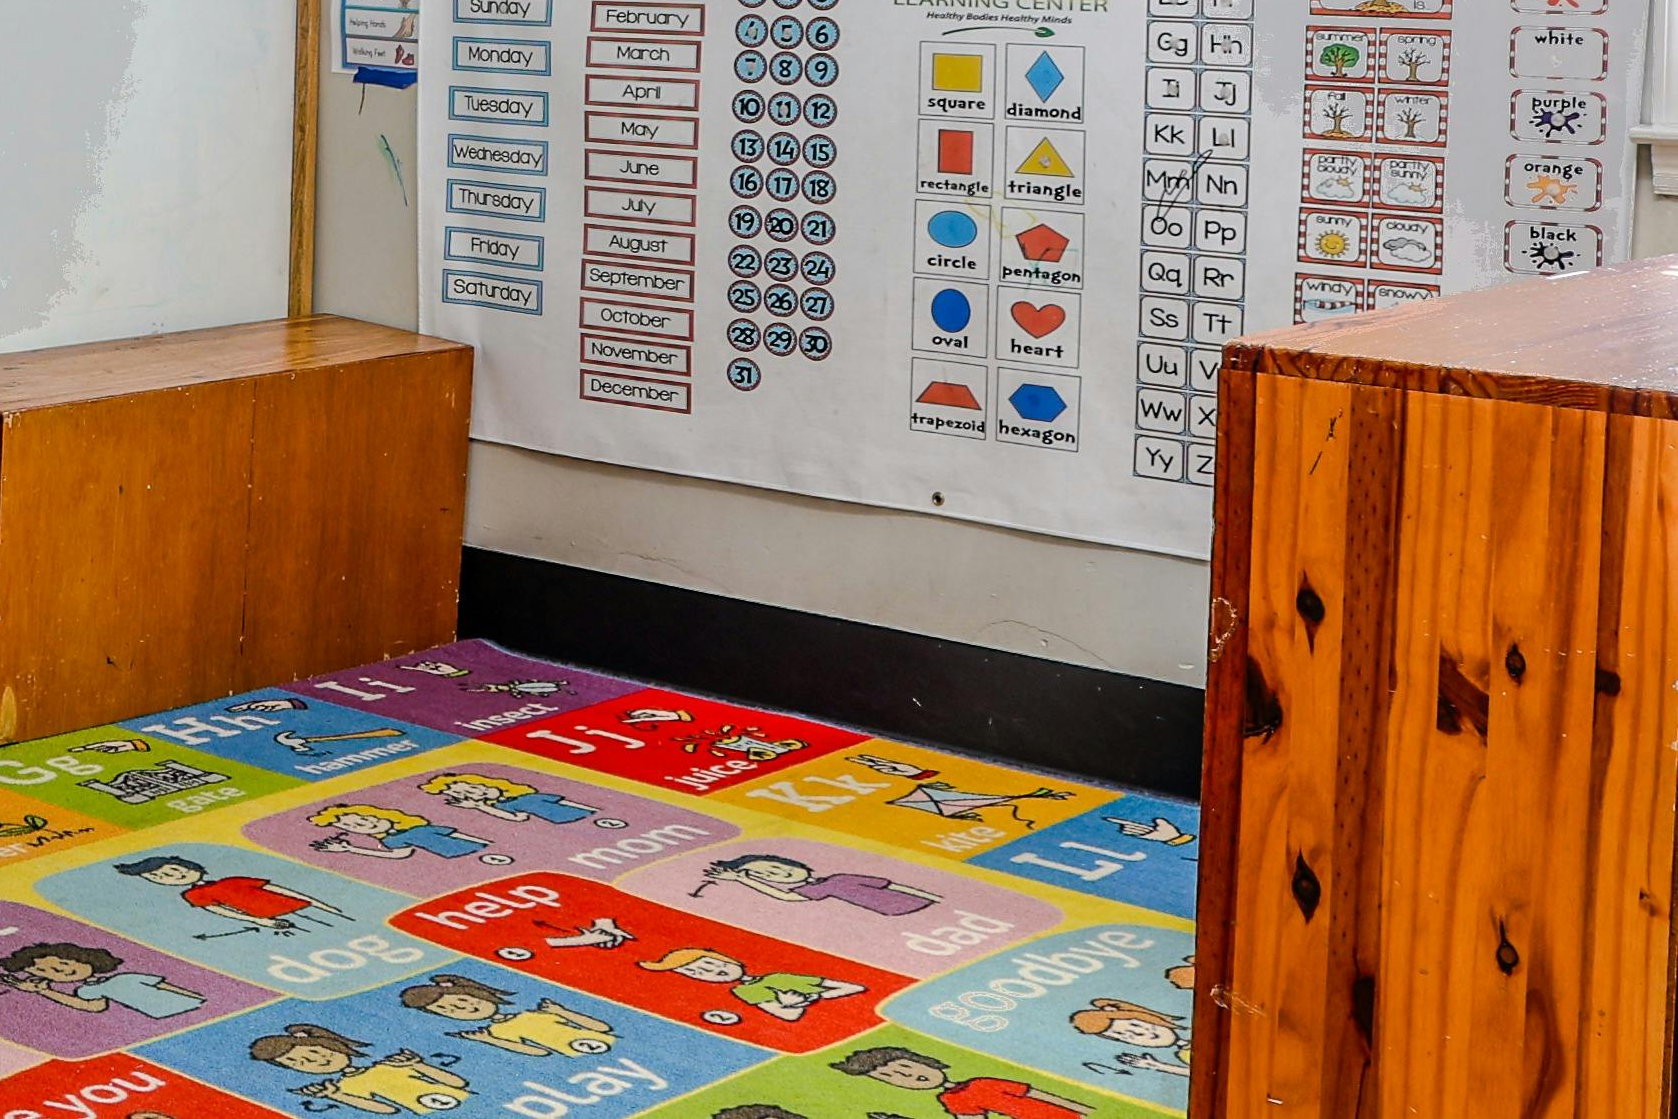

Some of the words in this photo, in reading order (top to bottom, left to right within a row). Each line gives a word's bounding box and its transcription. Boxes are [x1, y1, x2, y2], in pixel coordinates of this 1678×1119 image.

[606, 10, 690, 28] February
[927, 11, 964, 21] Healthy
[966, 13, 998, 22] Bodies
[1001, 14, 1039, 23] Healthy
[1042, 15, 1072, 24] Minds
[1535, 31, 1583, 45] white
[468, 47, 533, 66] Monday
[617, 46, 670, 62] March
[622, 83, 661, 100] April
[464, 96, 532, 116] Tuesday
[738, 99, 760, 116] 10
[812, 102, 830, 119] 12
[928, 97, 986, 112] square
[1007, 104, 1081, 120] diamond
[1532, 97, 1586, 113] purple
[621, 121, 659, 138] May
[1154, 124, 1184, 144] Kk
[454, 144, 543, 168] Wednesday
[810, 144, 830, 161] 15
[620, 160, 659, 176] June
[1524, 163, 1583, 179] orange
[921, 180, 989, 196] rectangle
[1008, 181, 1081, 201] triangle
[1206, 175, 1237, 195] Nn
[459, 188, 534, 213] Thursday
[621, 198, 656, 216] July
[809, 220, 828, 237] 21
[1530, 227, 1577, 242] black
[471, 238, 519, 260] Friday
[609, 235, 668, 256] August
[770, 256, 792, 274] 23
[927, 255, 977, 270] circle
[590, 267, 684, 292] September
[1002, 266, 1081, 284] pentagon
[1148, 263, 1182, 287] Qq
[454, 279, 531, 306] Saturday
[1307, 282, 1352, 295] windy
[601, 308, 671, 328] October
[932, 336, 968, 348] oval
[1011, 339, 1064, 358] heart
[591, 343, 678, 366] November
[735, 368, 754, 384] 31
[591, 379, 678, 403] December
[1140, 398, 1182, 422] Ww
[911, 413, 985, 432] trapezoid
[1000, 420, 1075, 444] hexagon
[315, 679, 415, 702] Ii
[455, 702, 559, 734] insect
[527, 726, 648, 754] Jj
[295, 737, 419, 775] hammer
[664, 757, 756, 792] juice
[167, 783, 245, 813] gate
[746, 770, 893, 814] Kk
[570, 821, 710, 870] mom
[922, 823, 1007, 854] kite
[416, 881, 560, 930] help
[904, 911, 1015, 957] dad
[266, 934, 425, 984] dog
[929, 926, 1154, 1033] goodbye
[43, 1072, 166, 1119] you
[503, 1058, 668, 1119] play
